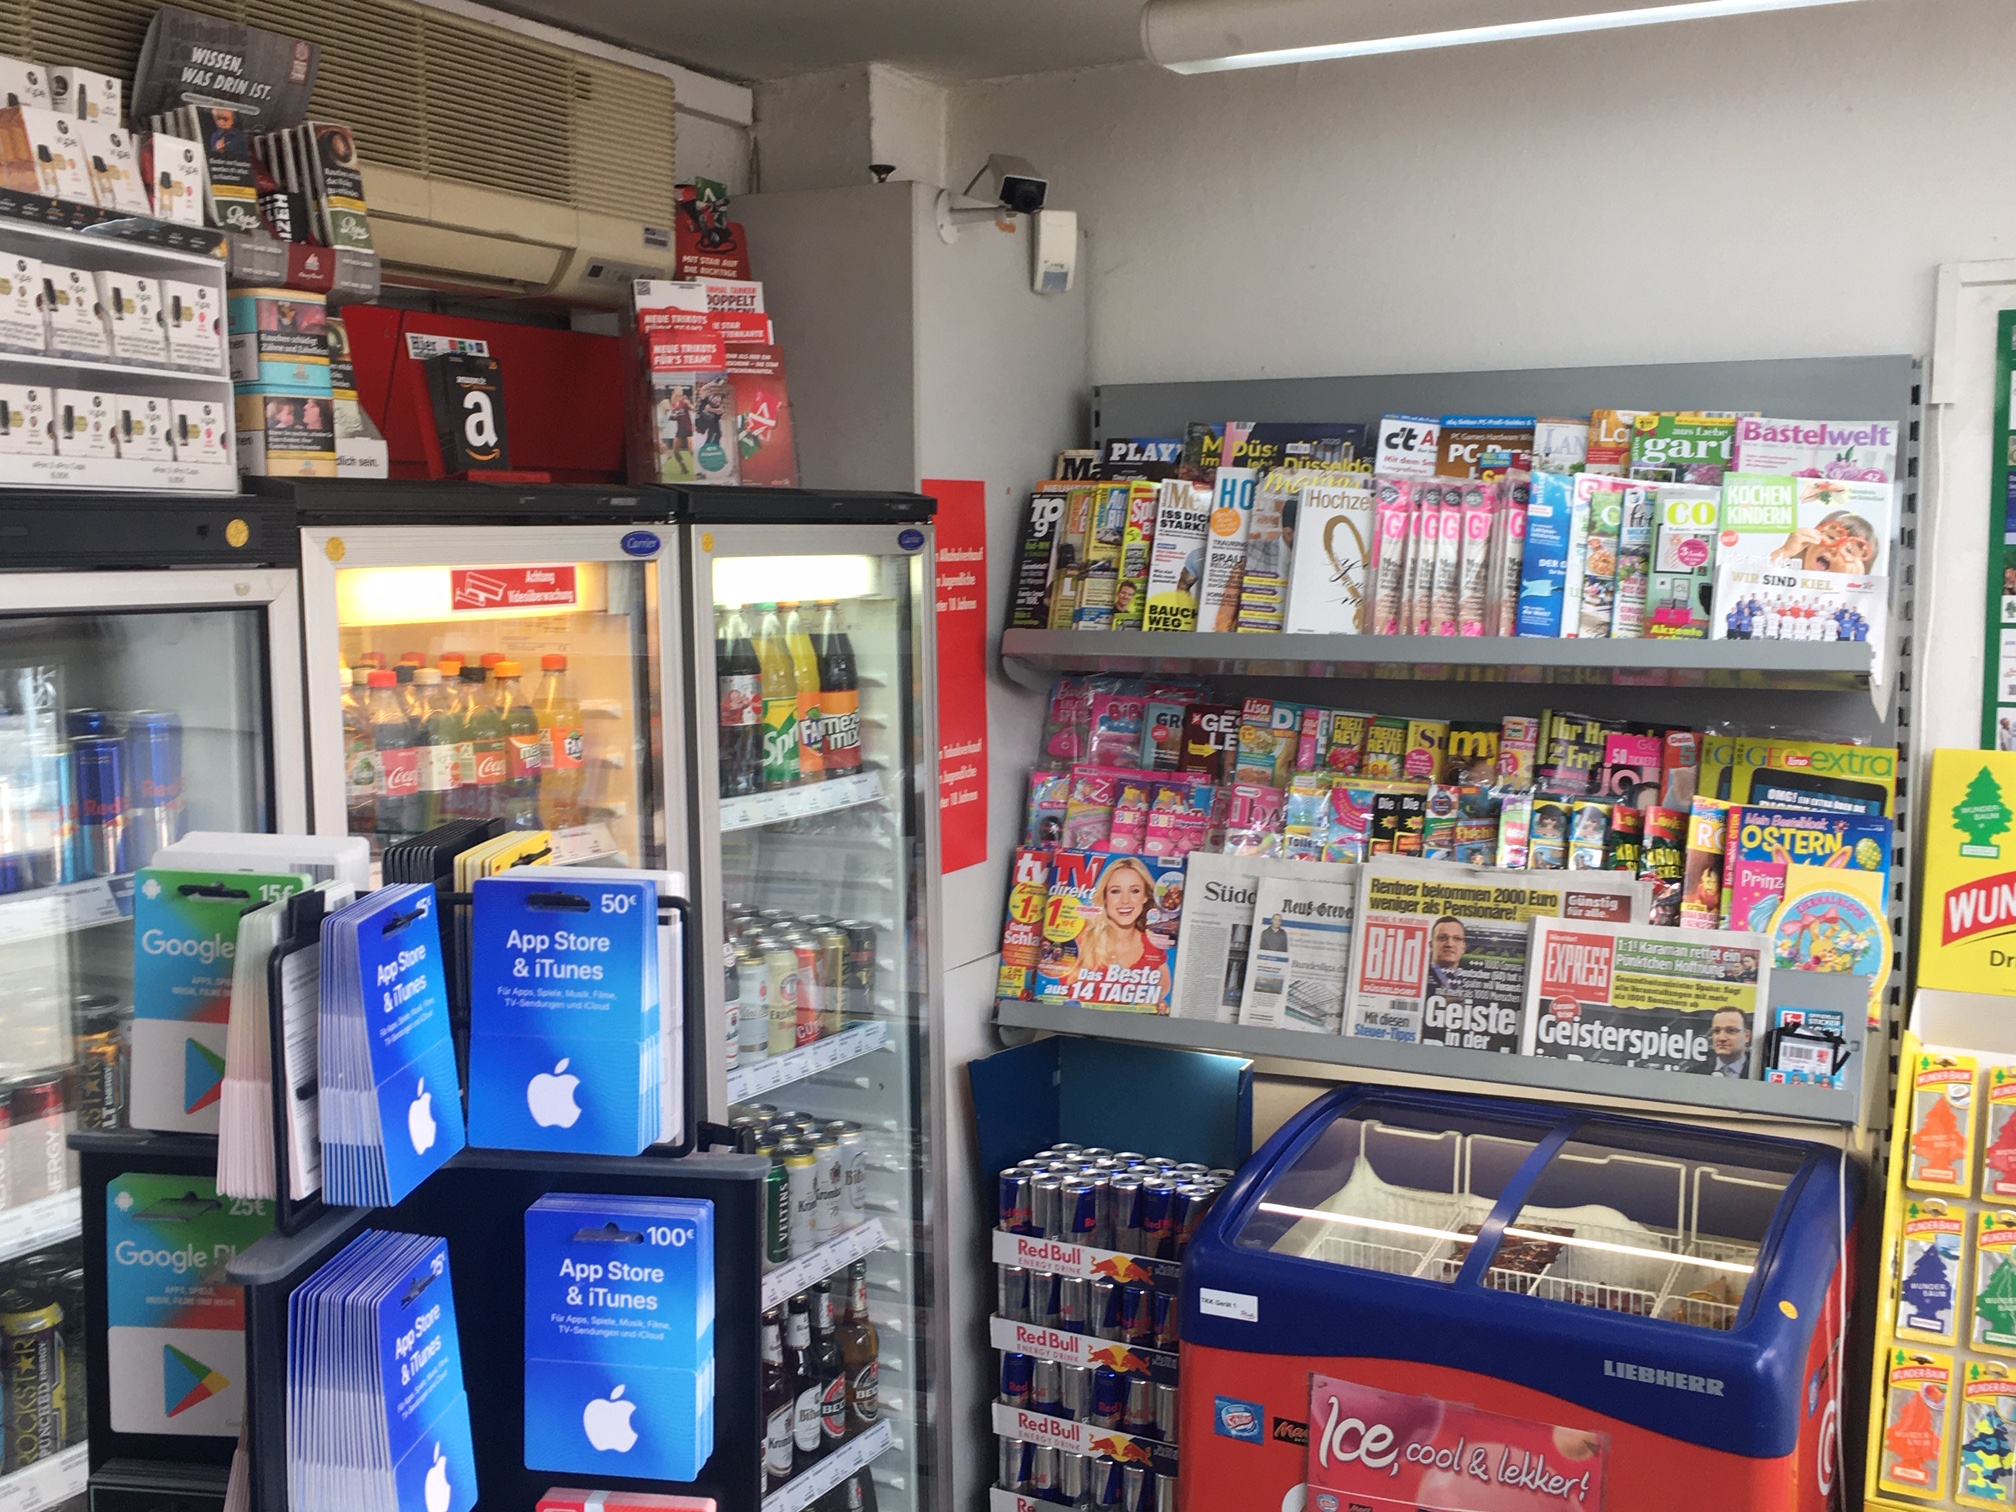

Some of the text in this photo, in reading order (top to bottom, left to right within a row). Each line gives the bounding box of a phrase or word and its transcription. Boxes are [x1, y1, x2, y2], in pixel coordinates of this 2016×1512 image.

[191, 47, 243, 76] WISSEN,
[181, 67, 272, 100] WAS DRIN IST.
[653, 343, 717, 354] NEUE TRIKOTS
[653, 354, 683, 366] FÜR'S
[462, 390, 499, 447] a
[1743, 421, 1891, 446] Bastelwelt
[1864, 473, 1881, 482] 42
[1727, 485, 1793, 506] KOCHEN
[1159, 519, 1207, 532] STARK!
[1161, 509, 1181, 521] ISS
[1727, 507, 1793, 525] KINDERN
[627, 536, 659, 550] Carrier
[525, 570, 556, 585] Achtung
[1731, 571, 1834, 591] WIR SIND KIEL
[506, 588, 574, 604] Videoüberwachung
[1148, 615, 1182, 626] WEG
[1244, 699, 1272, 715] Lisa
[1552, 716, 1583, 740] Ihr
[1809, 749, 1892, 777] extra
[1377, 797, 1395, 810] Die
[1402, 797, 1419, 811] Die
[1767, 788, 1798, 803] OMG!
[1961, 804, 2002, 814] WUNDER-
[1973, 812, 2000, 821] BAUM
[1741, 825, 1844, 856] OSTERN
[1017, 853, 1049, 884] tv
[1049, 880, 1097, 899] direkt
[1370, 878, 1558, 907] Rentner bekommen 2000 Euro
[600, 893, 638, 914] 50€
[1370, 896, 1518, 921] weniger als Pensionäre!
[1566, 906, 1610, 918] für alle.
[1567, 895, 1619, 912] Günstig
[141, 928, 235, 965] Google
[506, 929, 611, 954] App Store
[1618, 939, 1741, 962] 1:1! Karaman rettet ein
[1364, 926, 1424, 983] Bild
[377, 943, 427, 988] App Store
[512, 957, 604, 982] & iTunes
[1078, 964, 1162, 984] Das Beste
[1545, 943, 1610, 988] EXPRESS
[1615, 954, 1726, 979] Pünktchen Hoffnung
[383, 975, 427, 1014] & iTunes
[497, 986, 618, 1000] Für Apps, Spiele, Musik, Filme,
[1044, 981, 1162, 1004] aus 14 TAGEN
[1362, 984, 1418, 996] DÜSSELDORF
[1615, 984, 1729, 1003] alle Veranstaltungen mit mehr
[1627, 993, 1645, 1002] 1000
[1695, 983, 1721, 994] Spahn:
[504, 998, 610, 1011] TV-Sendungen und iCloud
[1364, 1011, 1410, 1028] Mit diesen
[1354, 1023, 1417, 1042] Steuer-Tipps
[1445, 1029, 1491, 1050] in der
[1538, 1014, 1709, 1062] Geisterspiele
[104, 1067, 114, 1106] ENERGY
[646, 1226, 695, 1248] 100€
[114, 1239, 208, 1274] Google
[1017, 1238, 1081, 1266] Red Bull
[559, 1258, 665, 1283] App Store
[1018, 1257, 1082, 1275] ENERGY DRINK
[1910, 1282, 1947, 1291] WUNDER-
[1923, 1289, 1947, 1298] BAUM
[565, 1286, 658, 1311] & iTunes
[394, 1329, 415, 1361] App
[411, 1303, 442, 1341] Store
[551, 1313, 672, 1331] Für Apps, Spiele, Musik, Filme,
[558, 1325, 664, 1341] TV-Sendungen und iCloud
[1016, 1325, 1079, 1353] Red Bull
[400, 1335, 442, 1386] & iTunes
[1016, 1343, 1079, 1363] ENERGY DRINK
[1603, 1357, 1726, 1398] LIEBHERR
[38, 1341, 51, 1458] PUNCHED ENERGY
[1017, 1412, 1080, 1442] Red Bull
[1018, 1430, 1081, 1451] ENERGY DRINK
[1318, 1394, 1591, 1502] Ice, cool & lekker!
